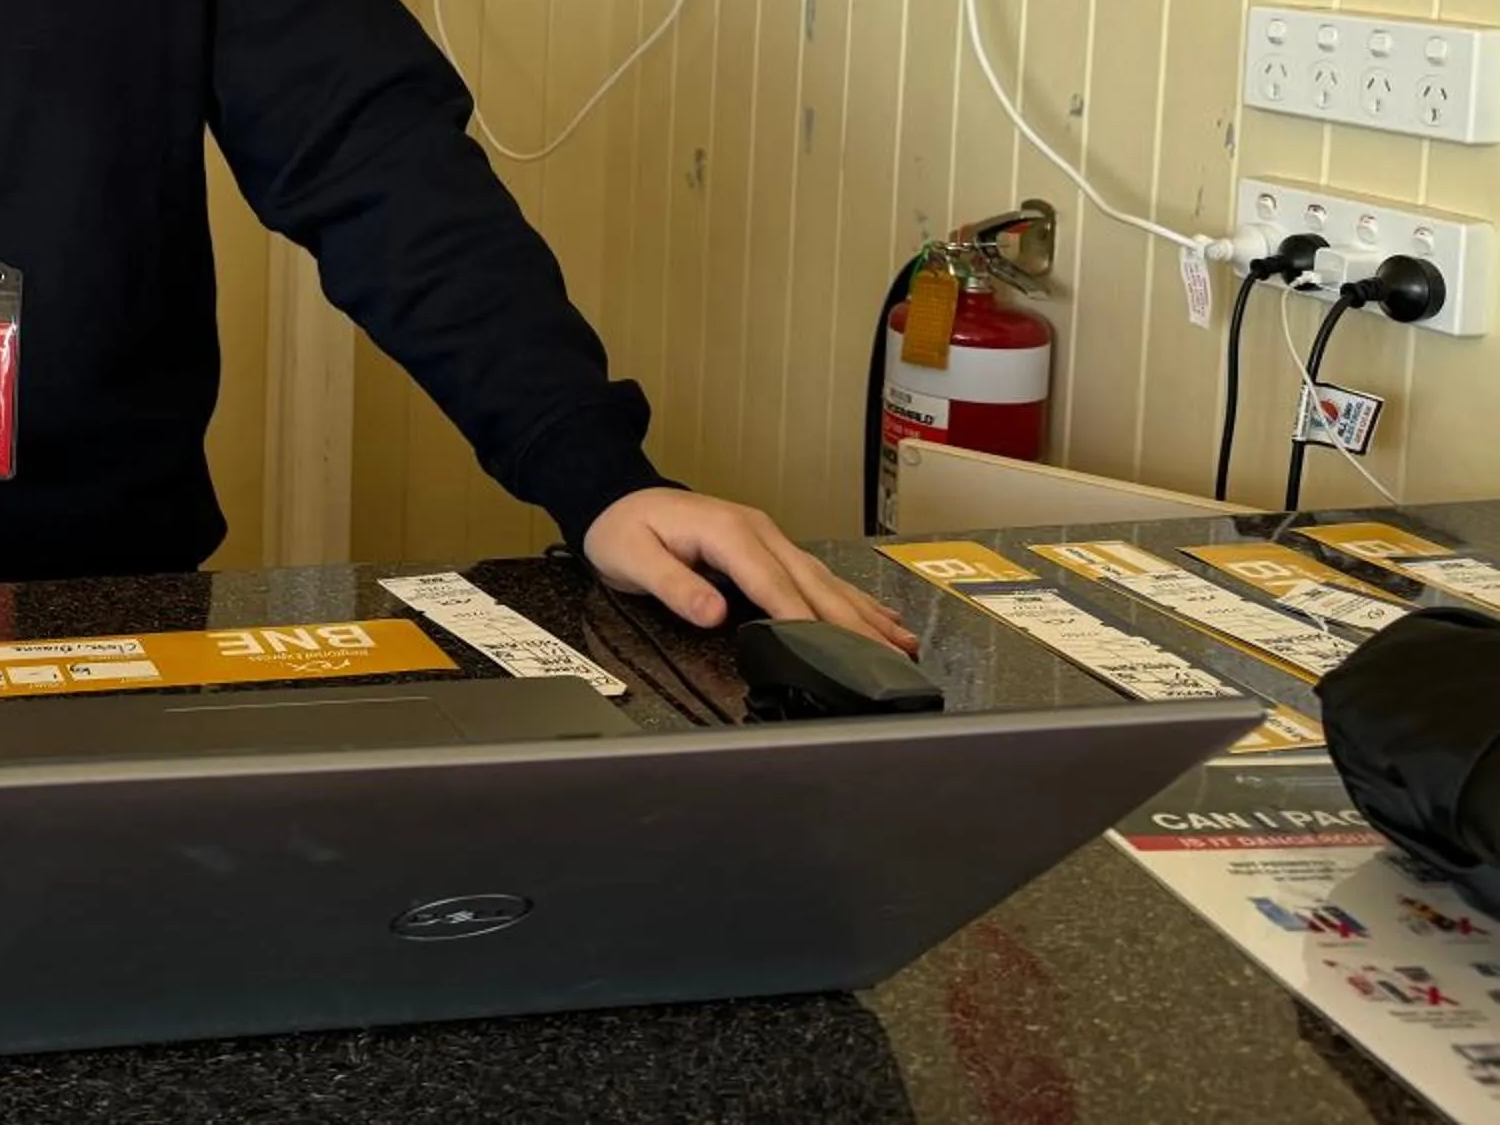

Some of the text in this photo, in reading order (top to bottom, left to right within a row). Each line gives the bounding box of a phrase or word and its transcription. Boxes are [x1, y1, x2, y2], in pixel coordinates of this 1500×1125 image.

[206, 624, 376, 657] BNE
[1152, 810, 1371, 831] CAN I PAC
[1209, 837, 1232, 848] IT
